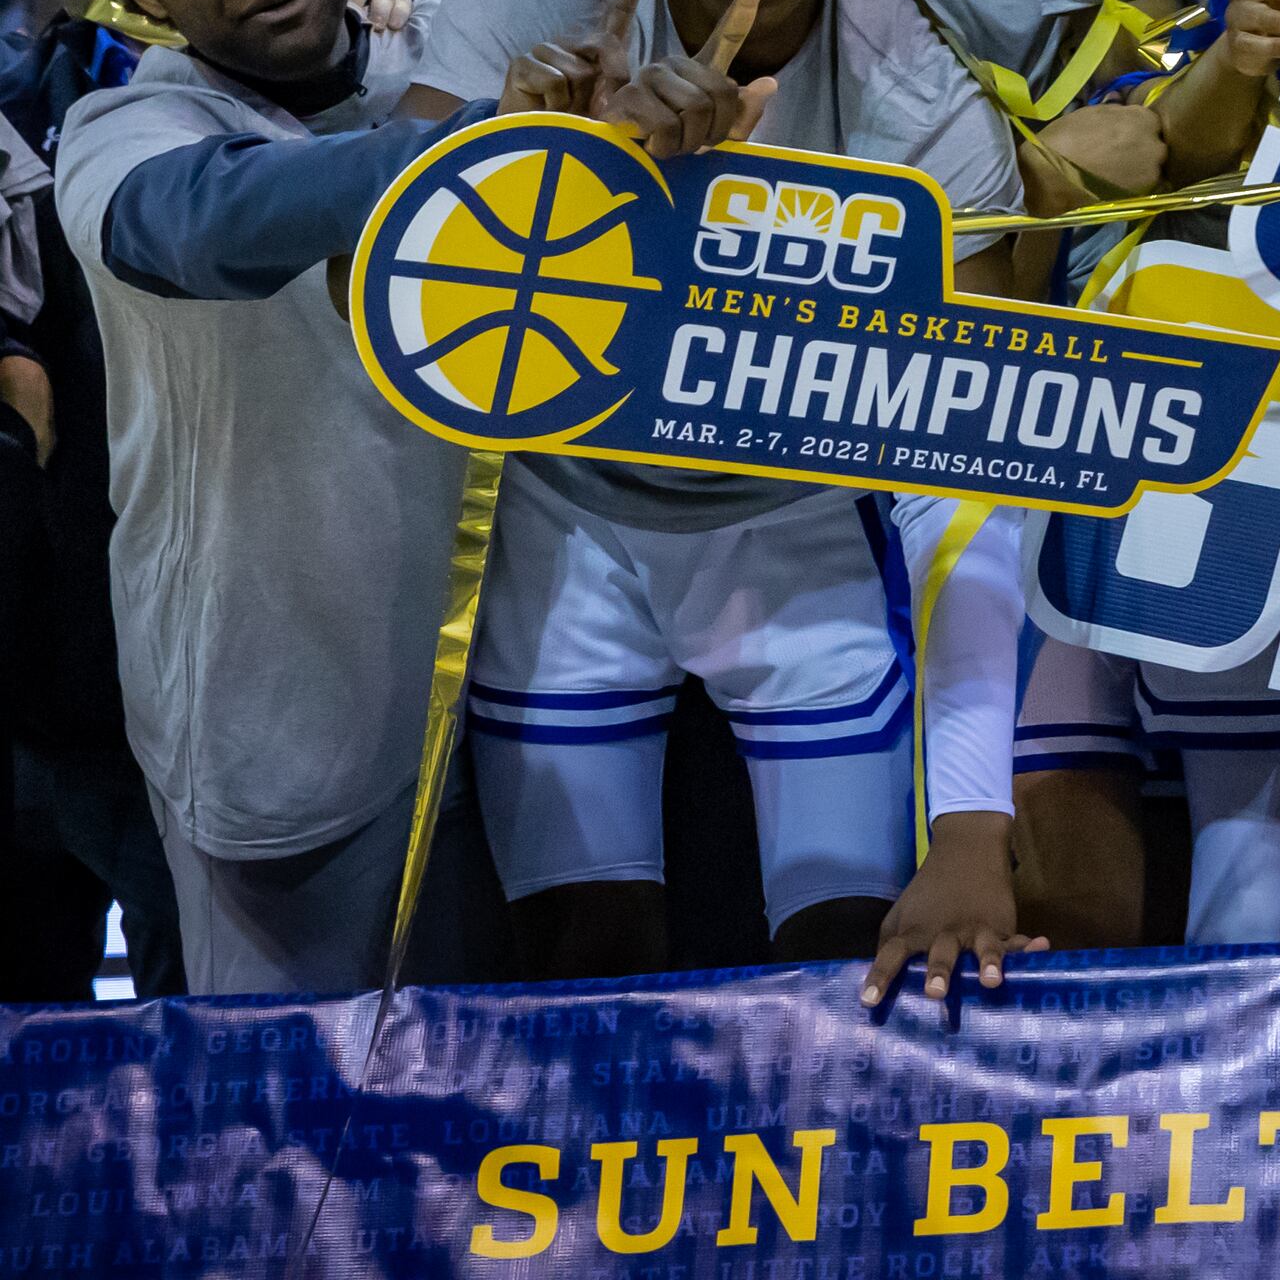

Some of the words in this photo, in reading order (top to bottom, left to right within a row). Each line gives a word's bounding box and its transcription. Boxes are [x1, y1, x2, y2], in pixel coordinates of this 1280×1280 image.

[693, 173, 906, 294] SBC
[685, 284, 817, 324] MEN'S
[837, 304, 1109, 364] BASKETBALL
[661, 322, 1203, 466] CHAMPIONS
[651, 418, 725, 446] MAR.
[736, 428, 789, 456] 2-7,
[800, 436, 871, 462] 2022
[893, 446, 1066, 489] PENSACOLA,
[1076, 470, 1109, 492] FL
[470, 1128, 837, 1259] SUN
